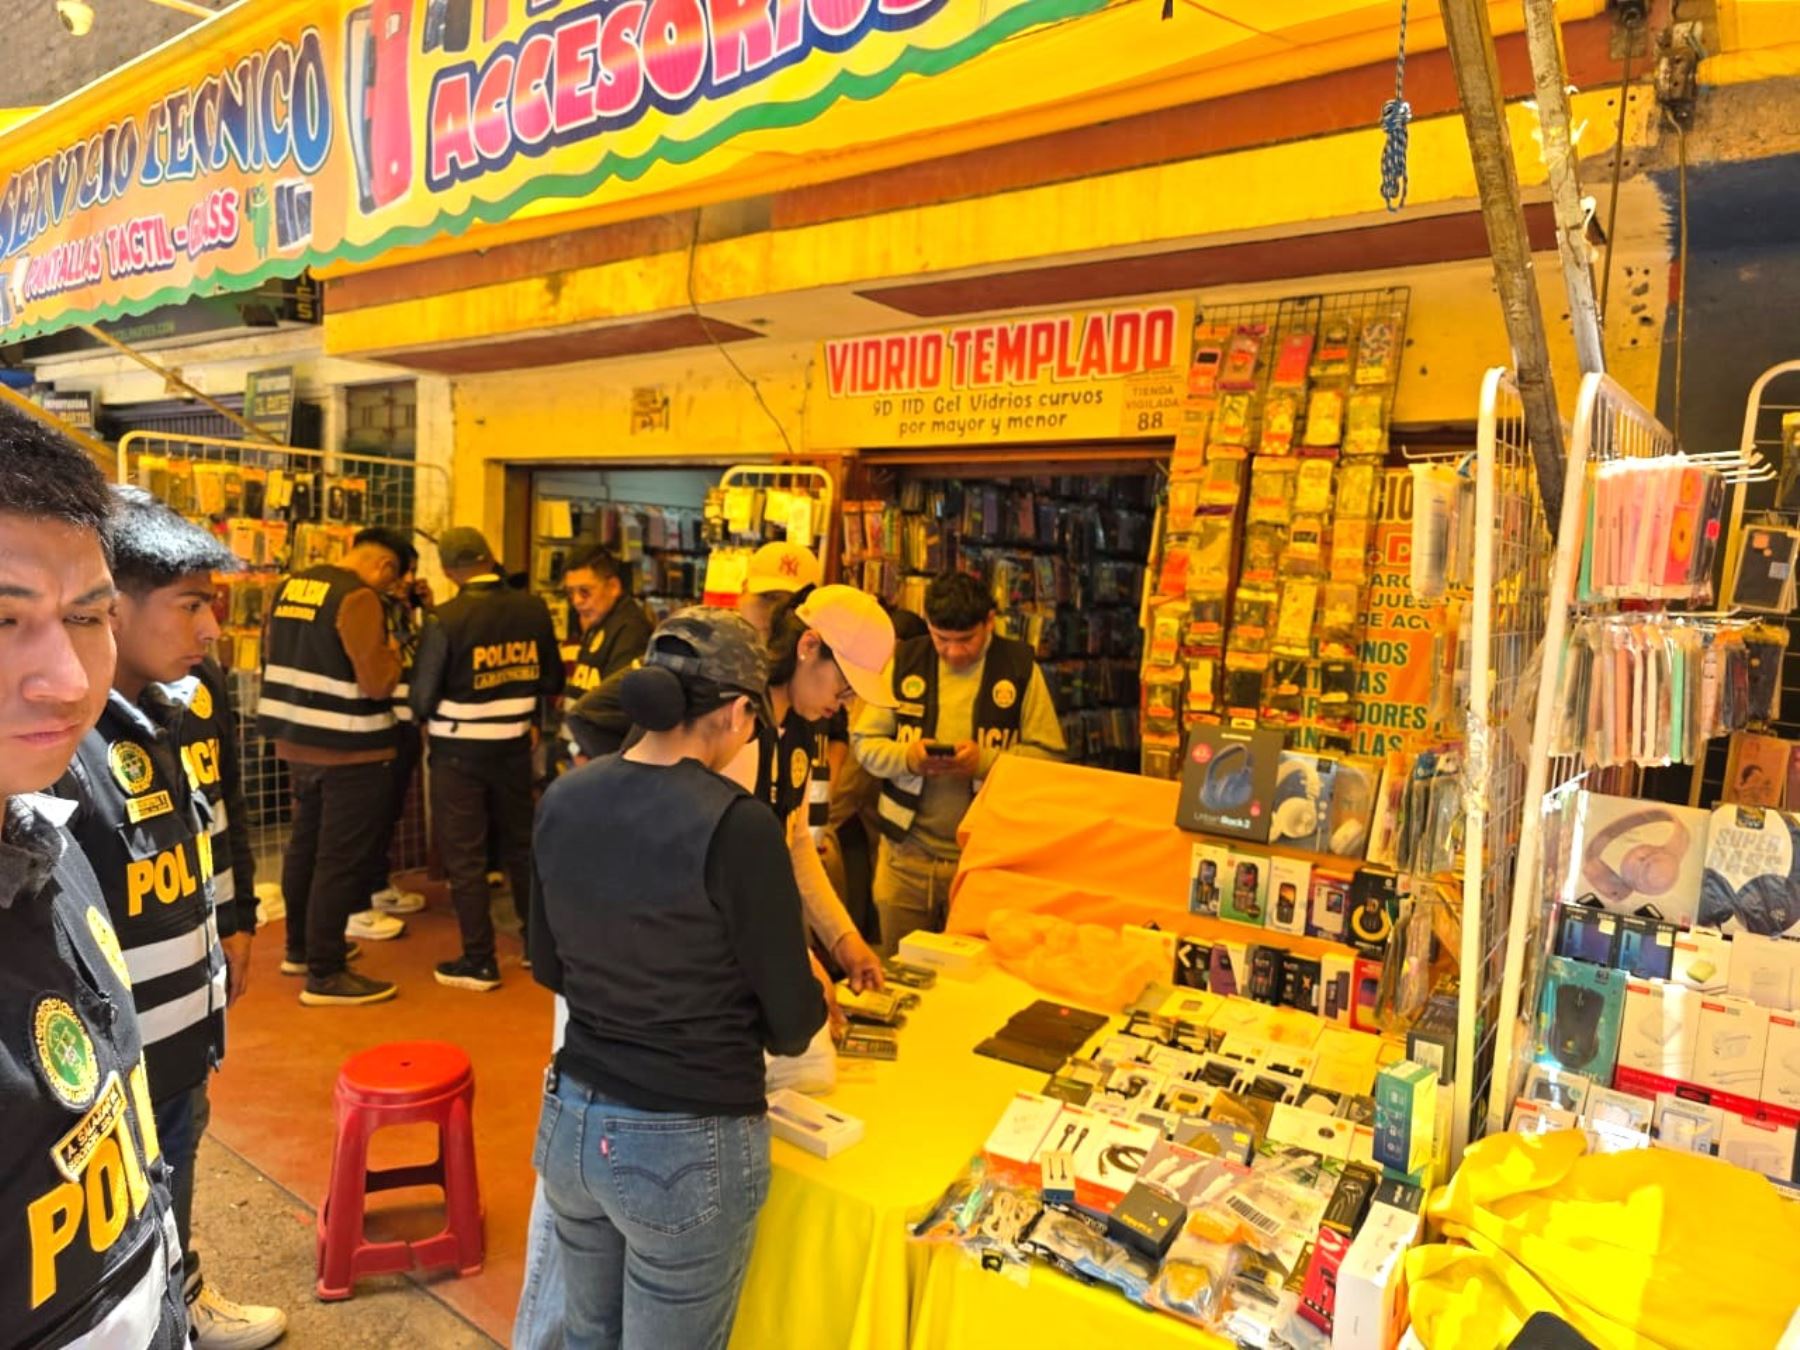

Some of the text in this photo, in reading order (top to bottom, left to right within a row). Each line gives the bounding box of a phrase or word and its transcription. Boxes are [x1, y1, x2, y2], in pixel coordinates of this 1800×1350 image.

[140, 28, 332, 184] TECNICO
[105, 214, 177, 278] TACTIL
[827, 308, 1175, 396] VIDRIO TEMPLADO
[933, 396, 961, 414] Gel
[970, 393, 1034, 412] Vidrios
[1039, 389, 1103, 406] curvos
[899, 411, 1068, 438] por mayor y menor
[1137, 411, 1163, 431] 88
[473, 640, 538, 670] POLICIA
